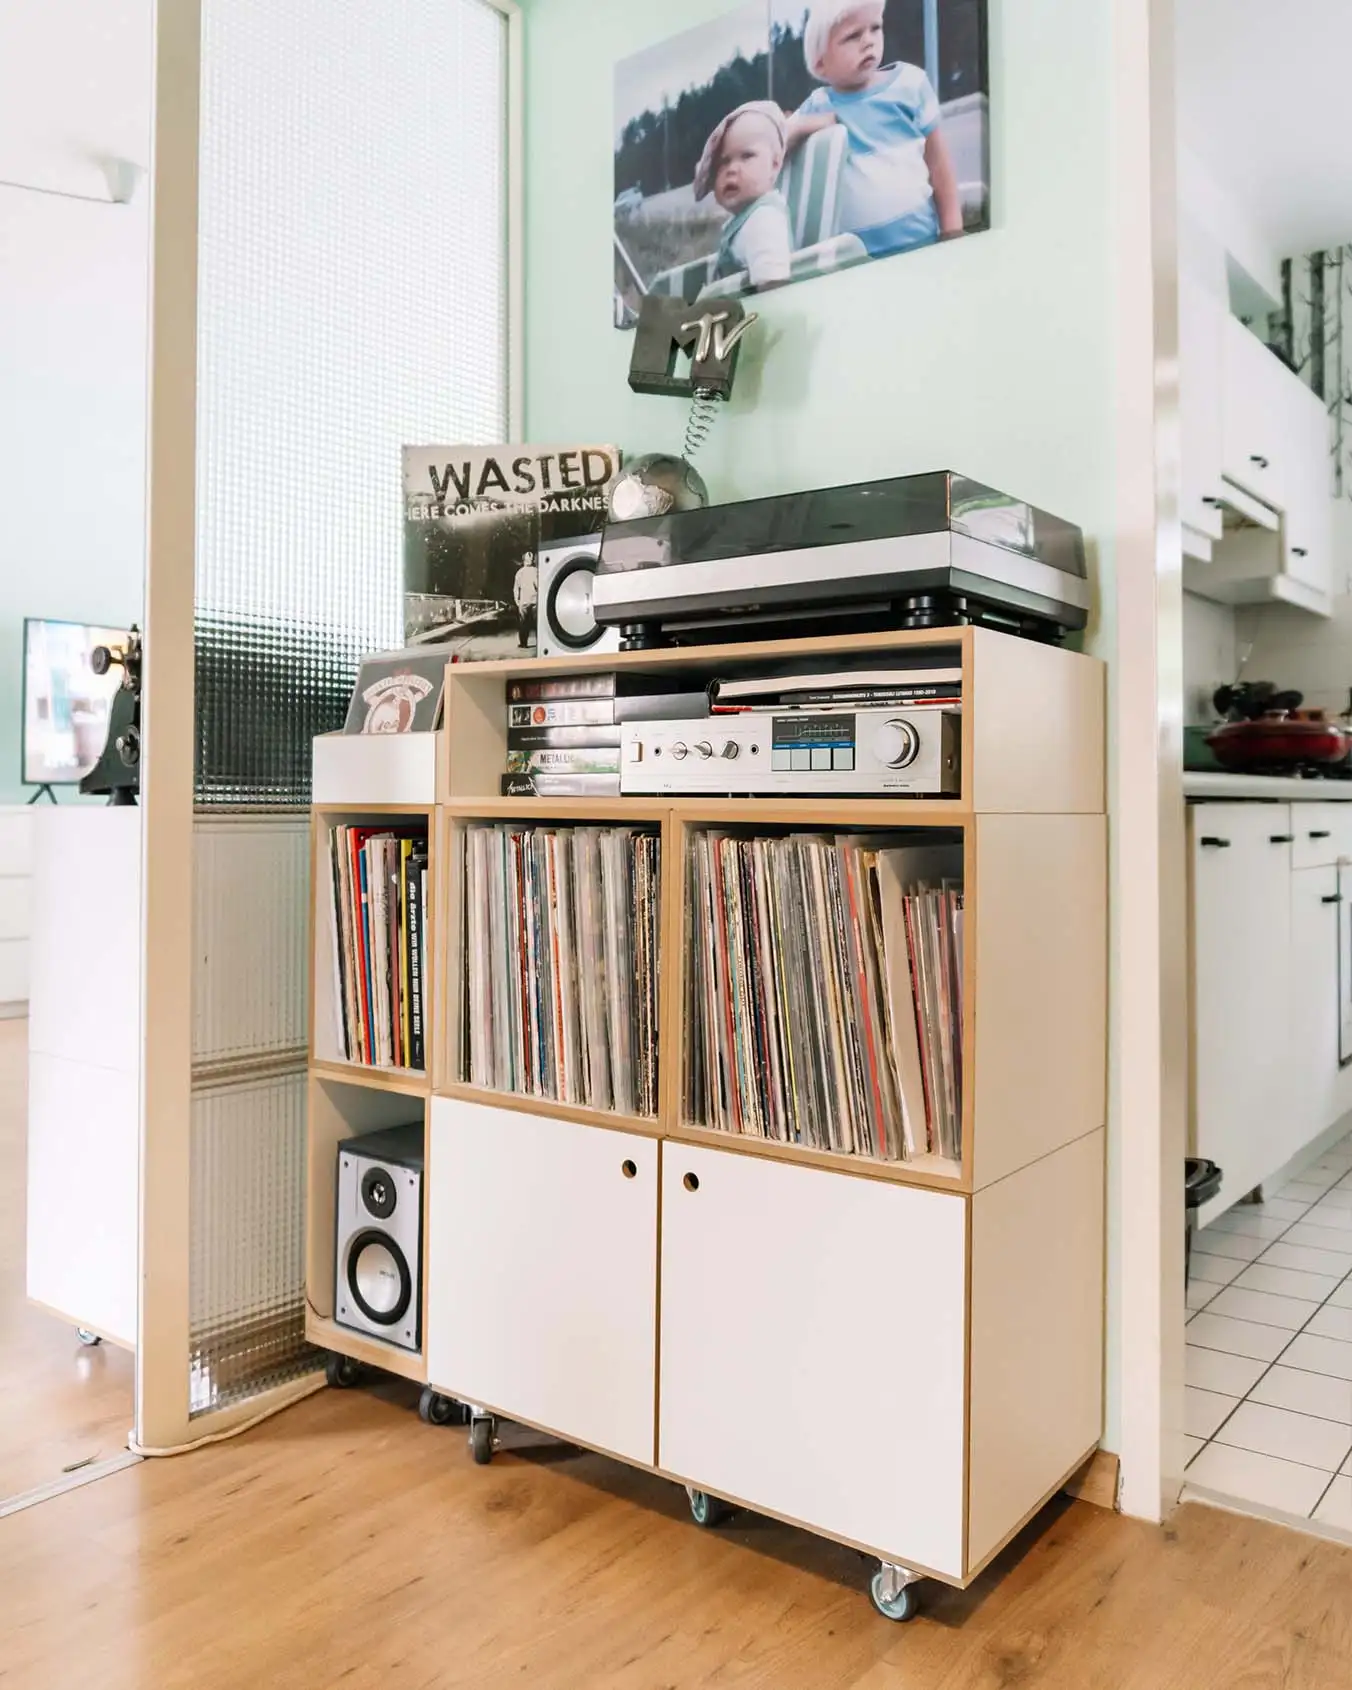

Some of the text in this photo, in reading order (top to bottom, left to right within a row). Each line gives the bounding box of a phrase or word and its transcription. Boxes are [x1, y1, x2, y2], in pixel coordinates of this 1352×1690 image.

[627, 295, 759, 402] MTV
[428, 449, 613, 502] WASTED
[443, 502, 499, 516] COMES
[503, 501, 534, 514] THE
[538, 497, 610, 513] DARKNES
